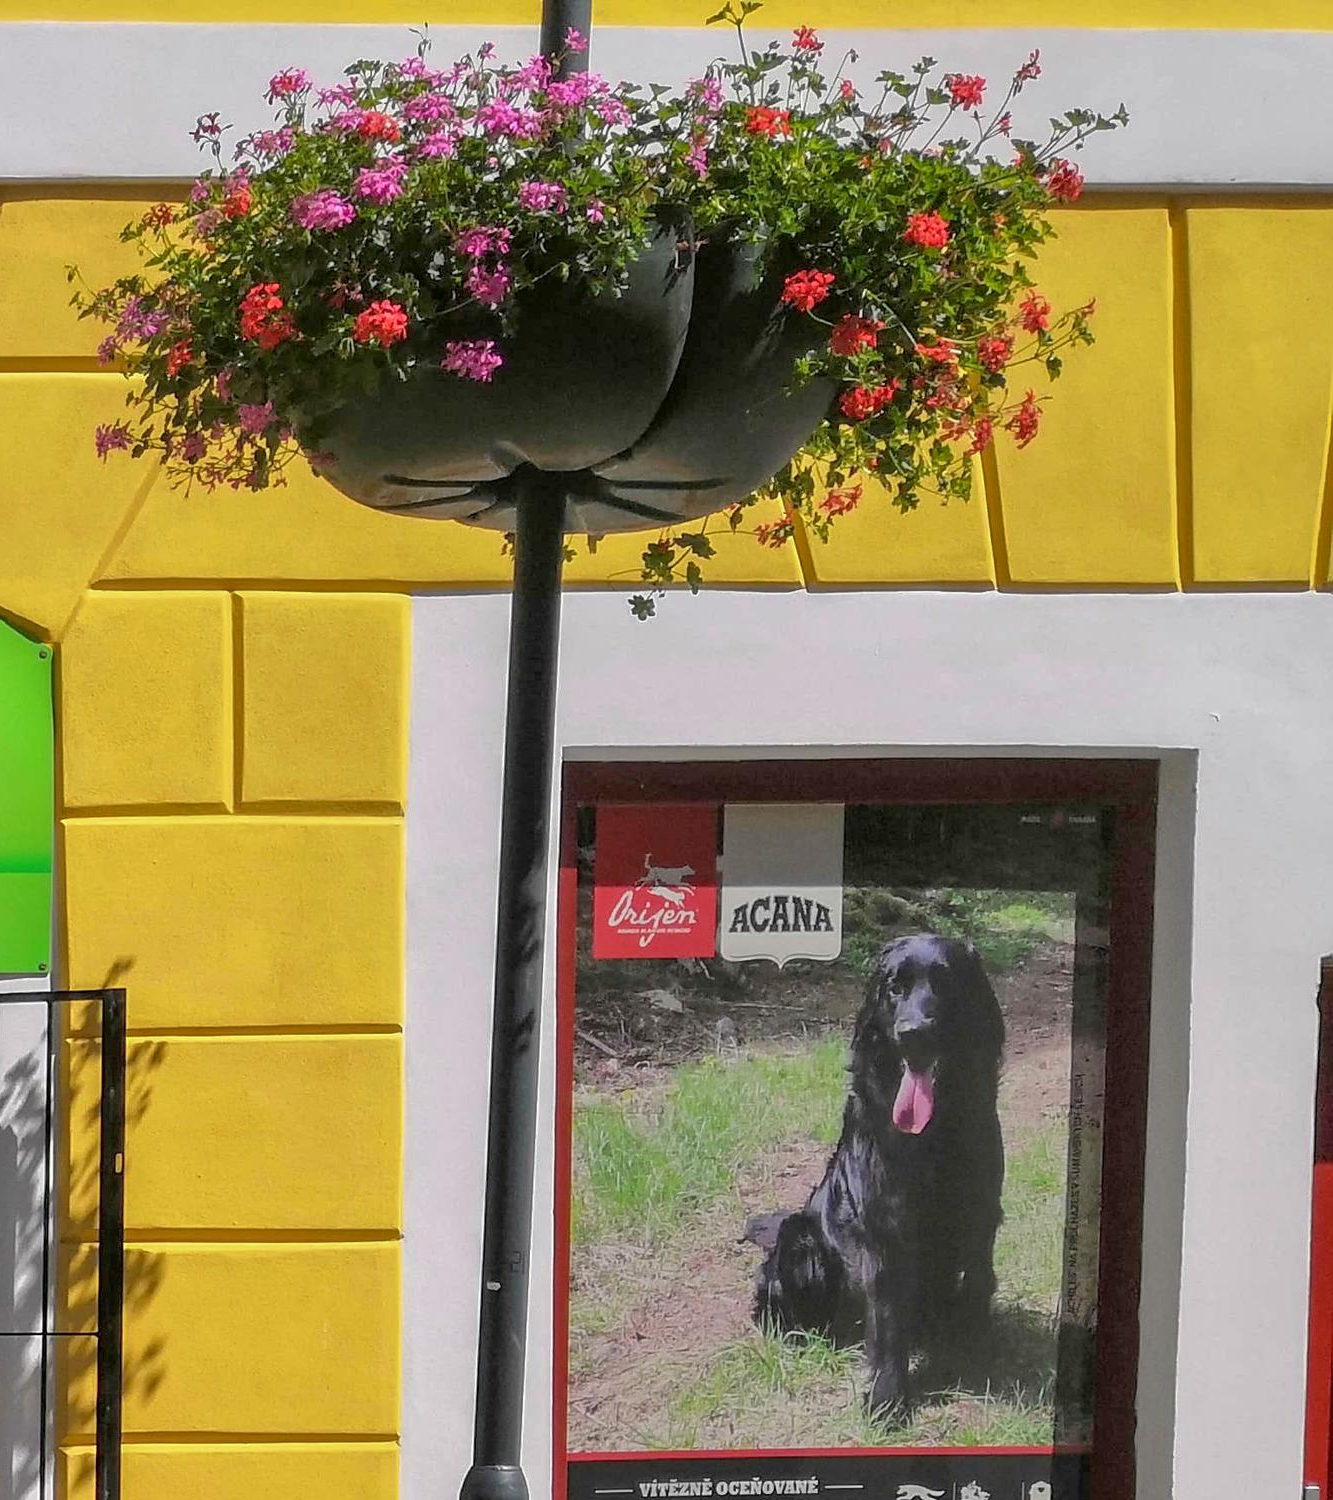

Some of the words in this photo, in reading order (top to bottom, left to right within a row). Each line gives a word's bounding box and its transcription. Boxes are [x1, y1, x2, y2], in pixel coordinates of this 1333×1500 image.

[608, 890, 697, 948] Orijen
[728, 895, 835, 933] ACANA
[639, 1478, 713, 1498] VÍTĚZNĚ
[715, 1475, 819, 1496] OCEŇOVANÉ
